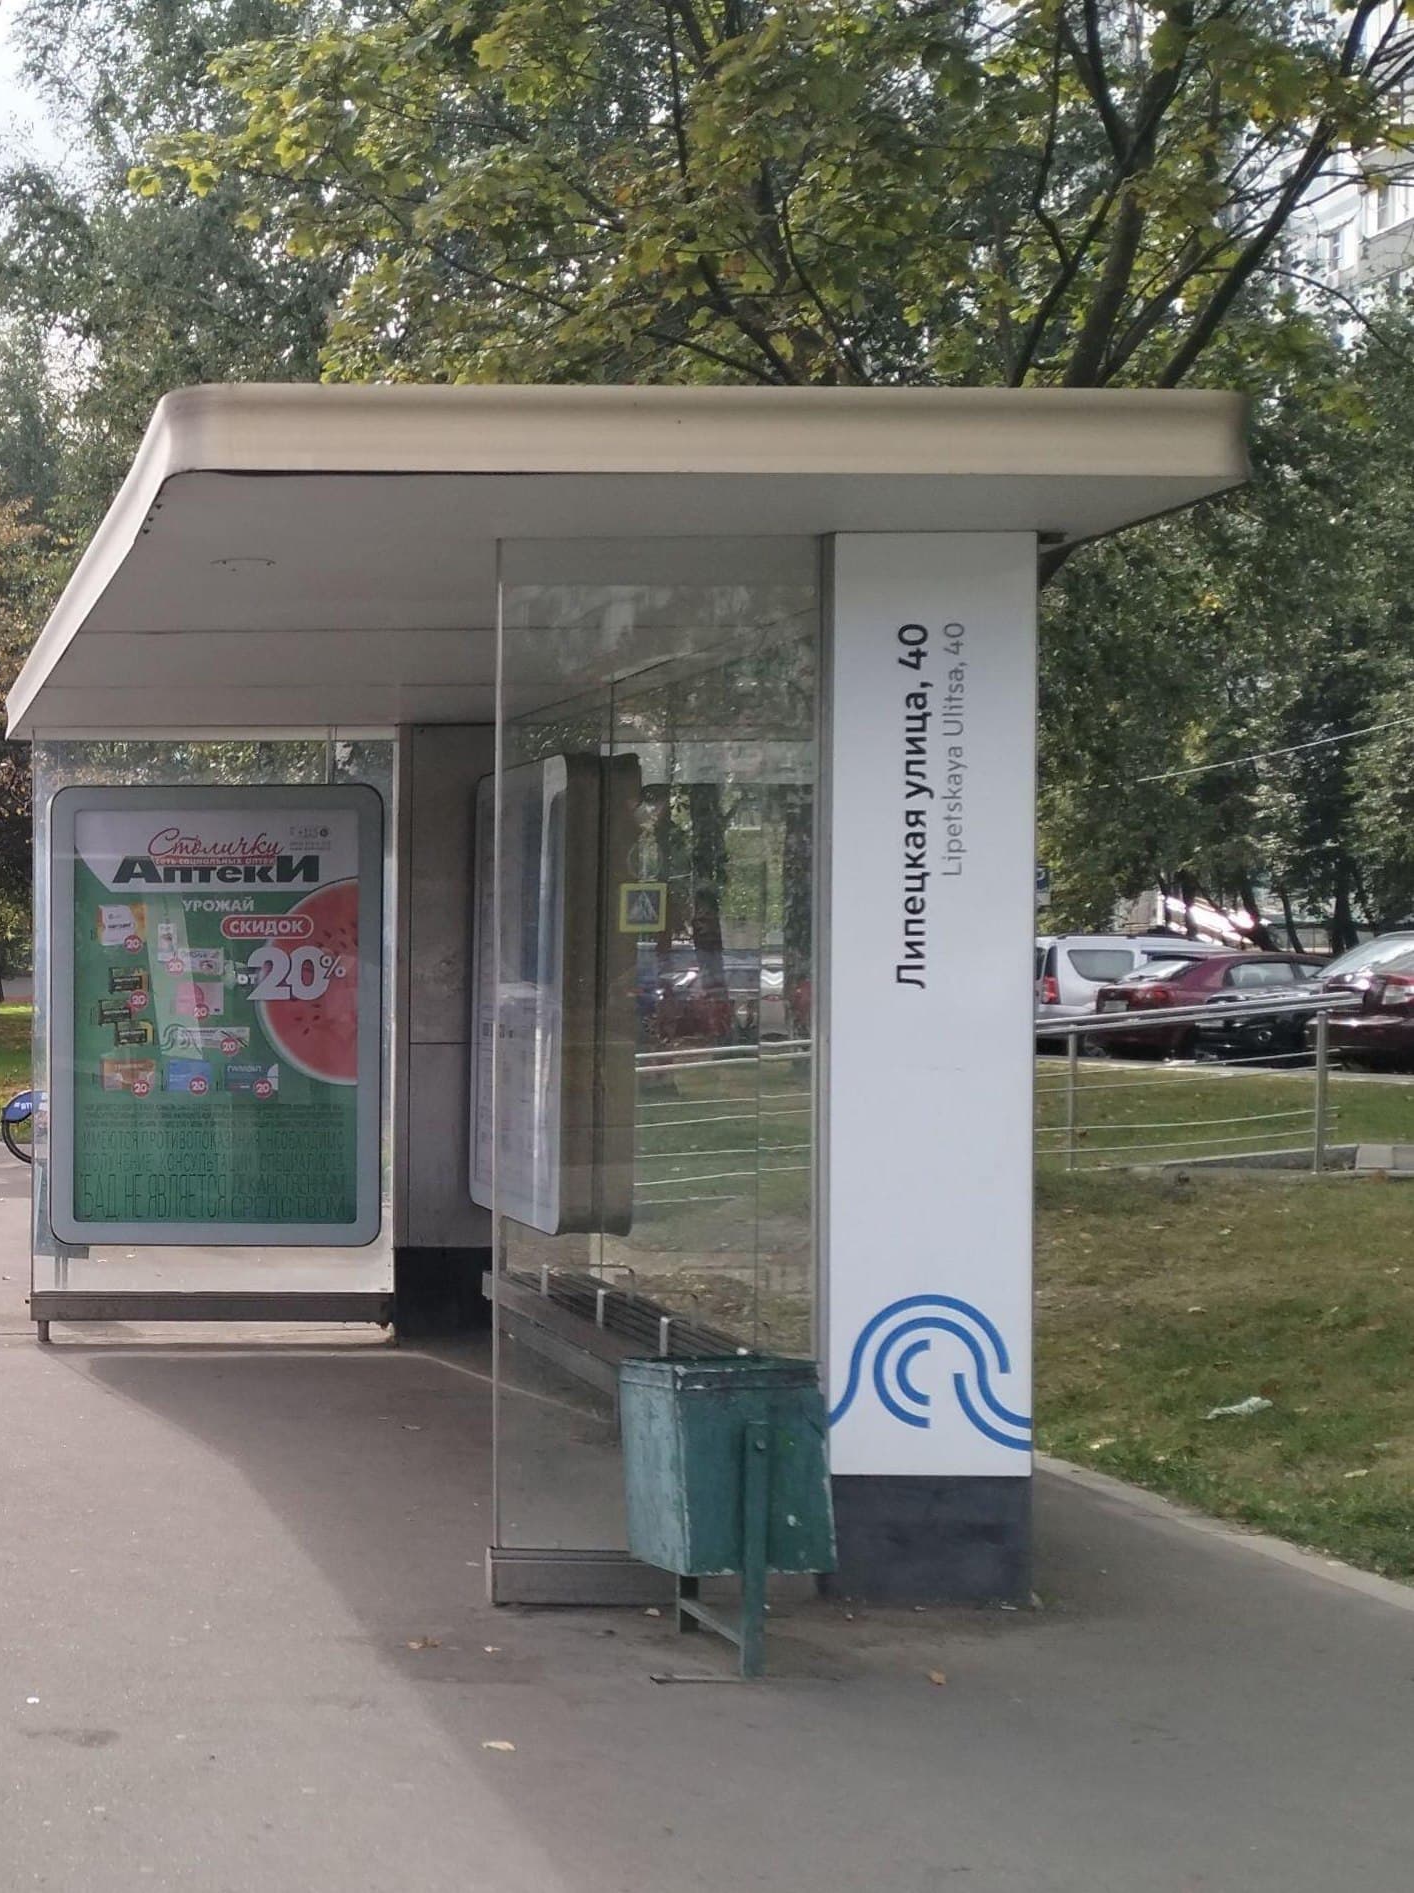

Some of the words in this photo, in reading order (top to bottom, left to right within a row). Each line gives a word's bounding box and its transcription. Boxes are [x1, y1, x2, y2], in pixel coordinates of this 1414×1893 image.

[898, 624, 928, 670] 40
[943, 622, 965, 656] 40
[942, 662, 968, 736] Ulitsa,
[905, 681, 934, 799] улица,
[941, 746, 968, 876] Lipetskaya
[148, 827, 283, 857] Столички
[182, 896, 255, 912] УРОЖАЙ
[895, 810, 931, 989] Липецкая
[229, 919, 304, 936] СКИДОК
